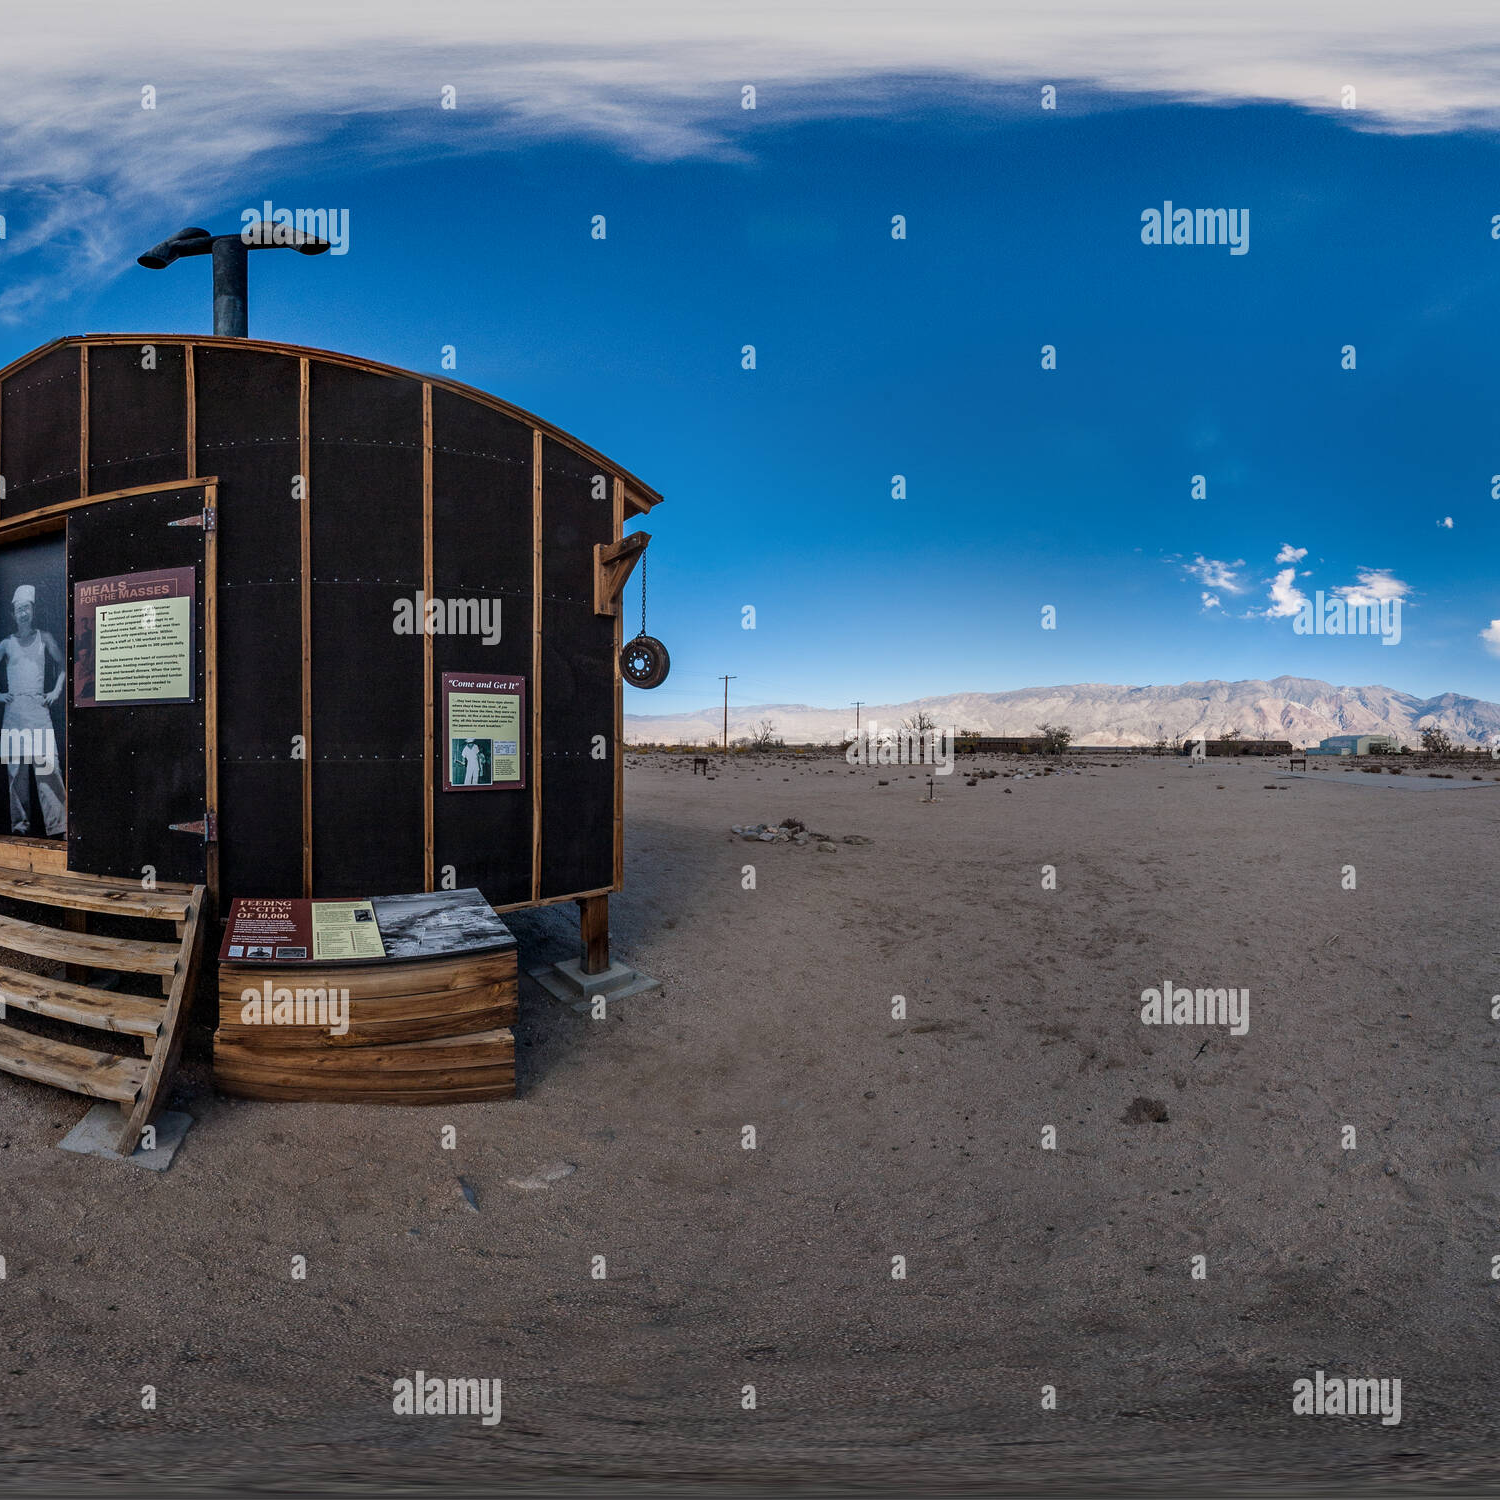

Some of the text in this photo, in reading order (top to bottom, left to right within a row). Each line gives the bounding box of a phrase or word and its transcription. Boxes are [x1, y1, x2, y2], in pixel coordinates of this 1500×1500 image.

[80, 581, 127, 597] MEALS
[80, 585, 169, 605] FOR THE MASSES
[448, 679, 520, 690] "Come and Get It"
